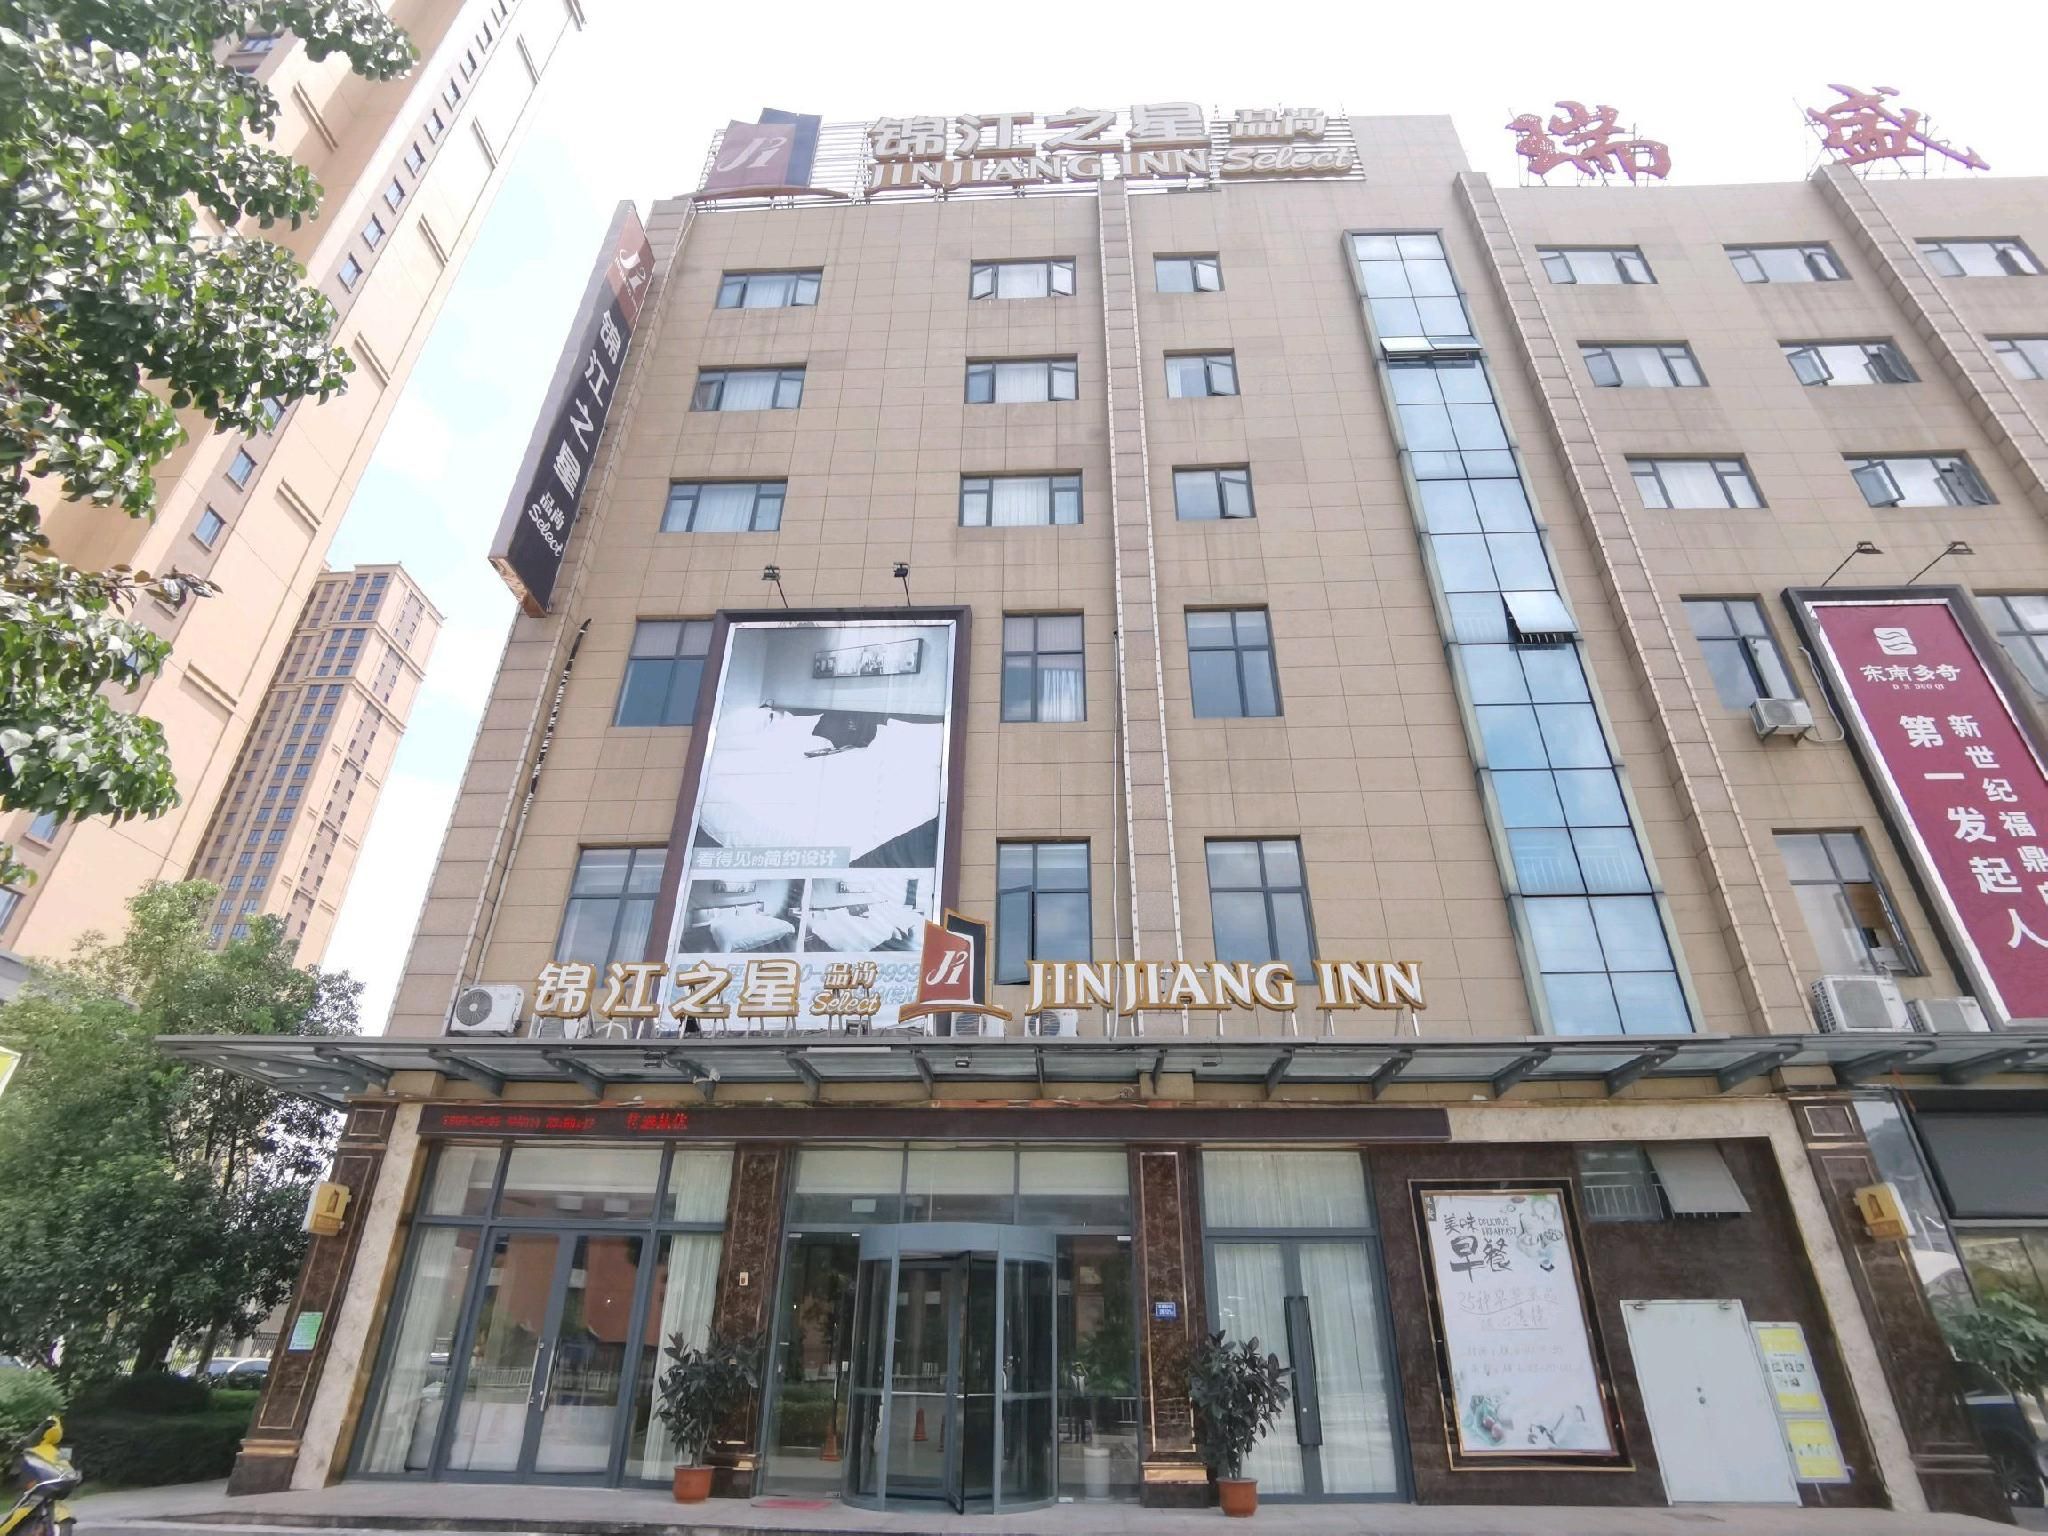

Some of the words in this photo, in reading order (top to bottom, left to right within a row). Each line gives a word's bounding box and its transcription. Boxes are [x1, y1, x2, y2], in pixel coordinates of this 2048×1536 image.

[866, 102, 1212, 161] 锦江之星
[1227, 105, 1330, 142] 品尚
[864, 153, 1106, 192] JINJIANG
[1120, 148, 1216, 181] INN
[1218, 145, 1354, 178] Select
[553, 309, 622, 500] 锦江之星
[527, 503, 565, 558] Select
[540, 490, 565, 531] 品尚
[1859, 663, 1961, 683] 东南多奇
[1899, 715, 2048, 949] 第一发起人
[696, 849, 838, 868] 看得见的简约设计
[534, 959, 801, 1019] 锦江之星
[824, 961, 880, 990] 品尚
[1025, 959, 1298, 1016] JINJIANG
[1312, 959, 1427, 1011] INN
[809, 991, 881, 1016] Select
[1444, 1212, 1476, 1235] 美味
[1450, 1235, 1513, 1283] 早餐
